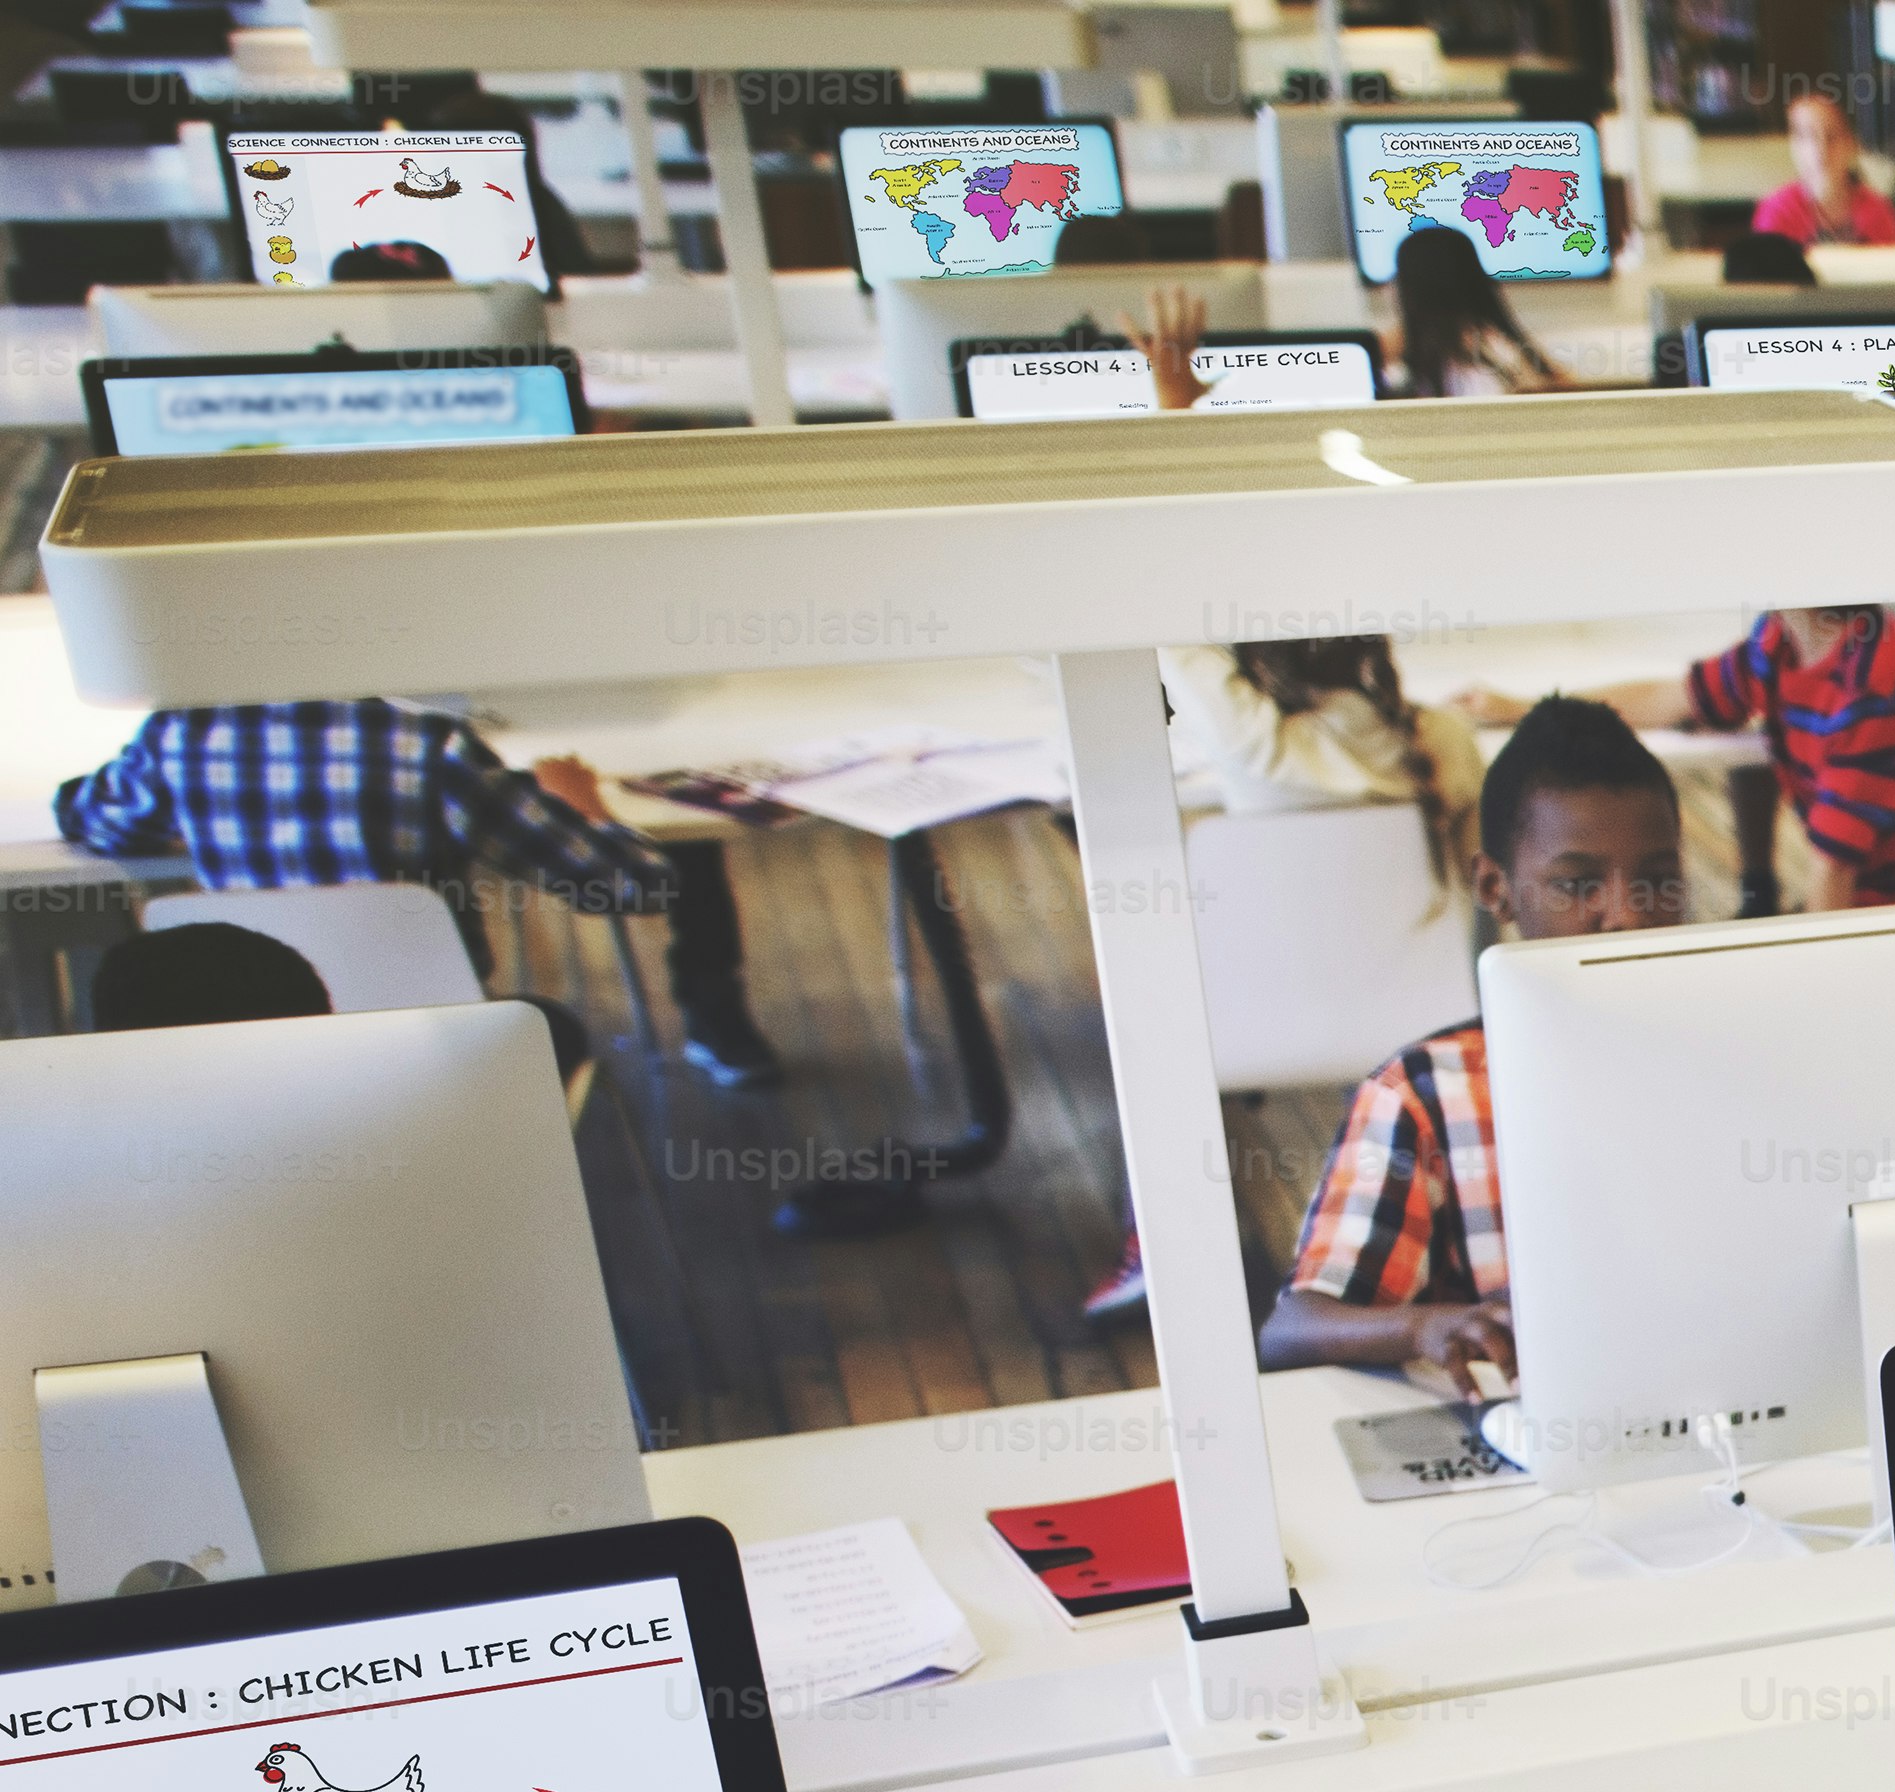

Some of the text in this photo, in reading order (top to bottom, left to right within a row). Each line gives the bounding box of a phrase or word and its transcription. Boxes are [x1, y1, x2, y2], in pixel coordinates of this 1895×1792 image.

[228, 138, 285, 148] SCIENCE
[293, 137, 379, 147] CONNECTION
[394, 137, 450, 146] CHICKEN
[455, 136, 483, 145] LIFE
[488, 136, 526, 145] CYCLE
[890, 134, 1071, 150] CONTINENTS AND OCEANS
[1390, 140, 1573, 151] CONTINENTS AND OCEANS
[1748, 339, 1823, 354] LESSON
[1832, 339, 1842, 352] 4
[1013, 359, 1100, 376] LESSON
[1109, 359, 1121, 373] 4
[1223, 354, 1268, 368] LIFE
[1278, 351, 1340, 366] CYCLE
[238, 1653, 424, 1704] CHICKEN
[441, 1638, 531, 1675] LIFE
[549, 1617, 672, 1658] CYCLE
